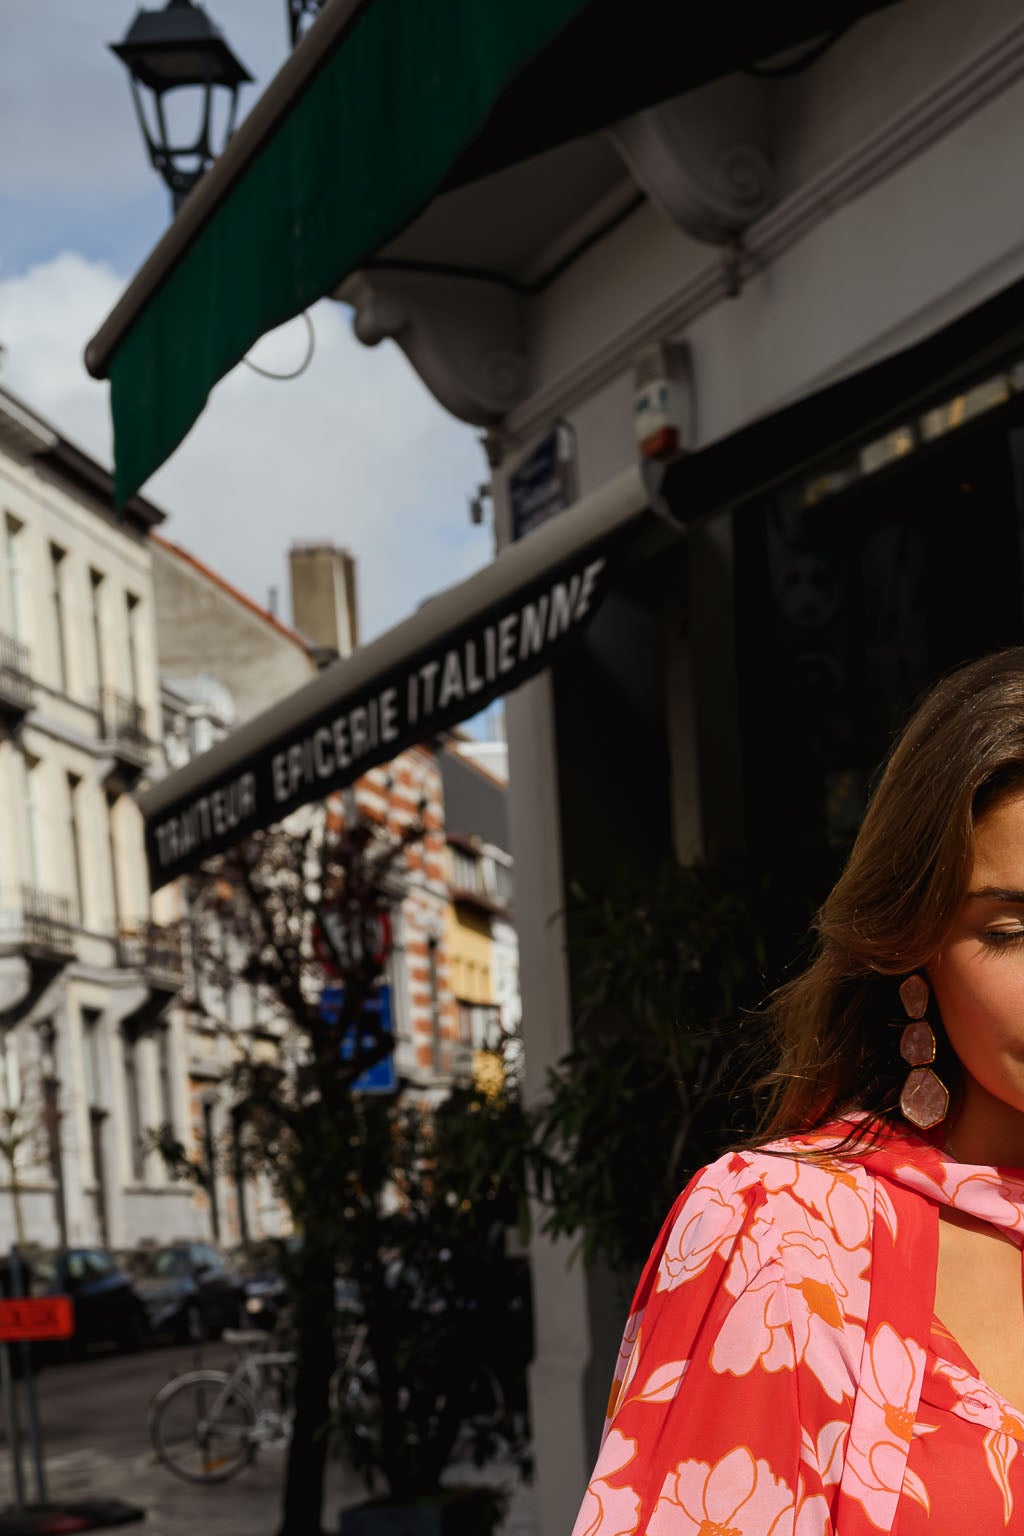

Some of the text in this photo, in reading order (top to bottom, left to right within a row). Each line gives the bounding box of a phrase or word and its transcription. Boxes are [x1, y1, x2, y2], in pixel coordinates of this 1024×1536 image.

[154, 557, 606, 867] TRAITEUR EPICERIE ITALIENNE
